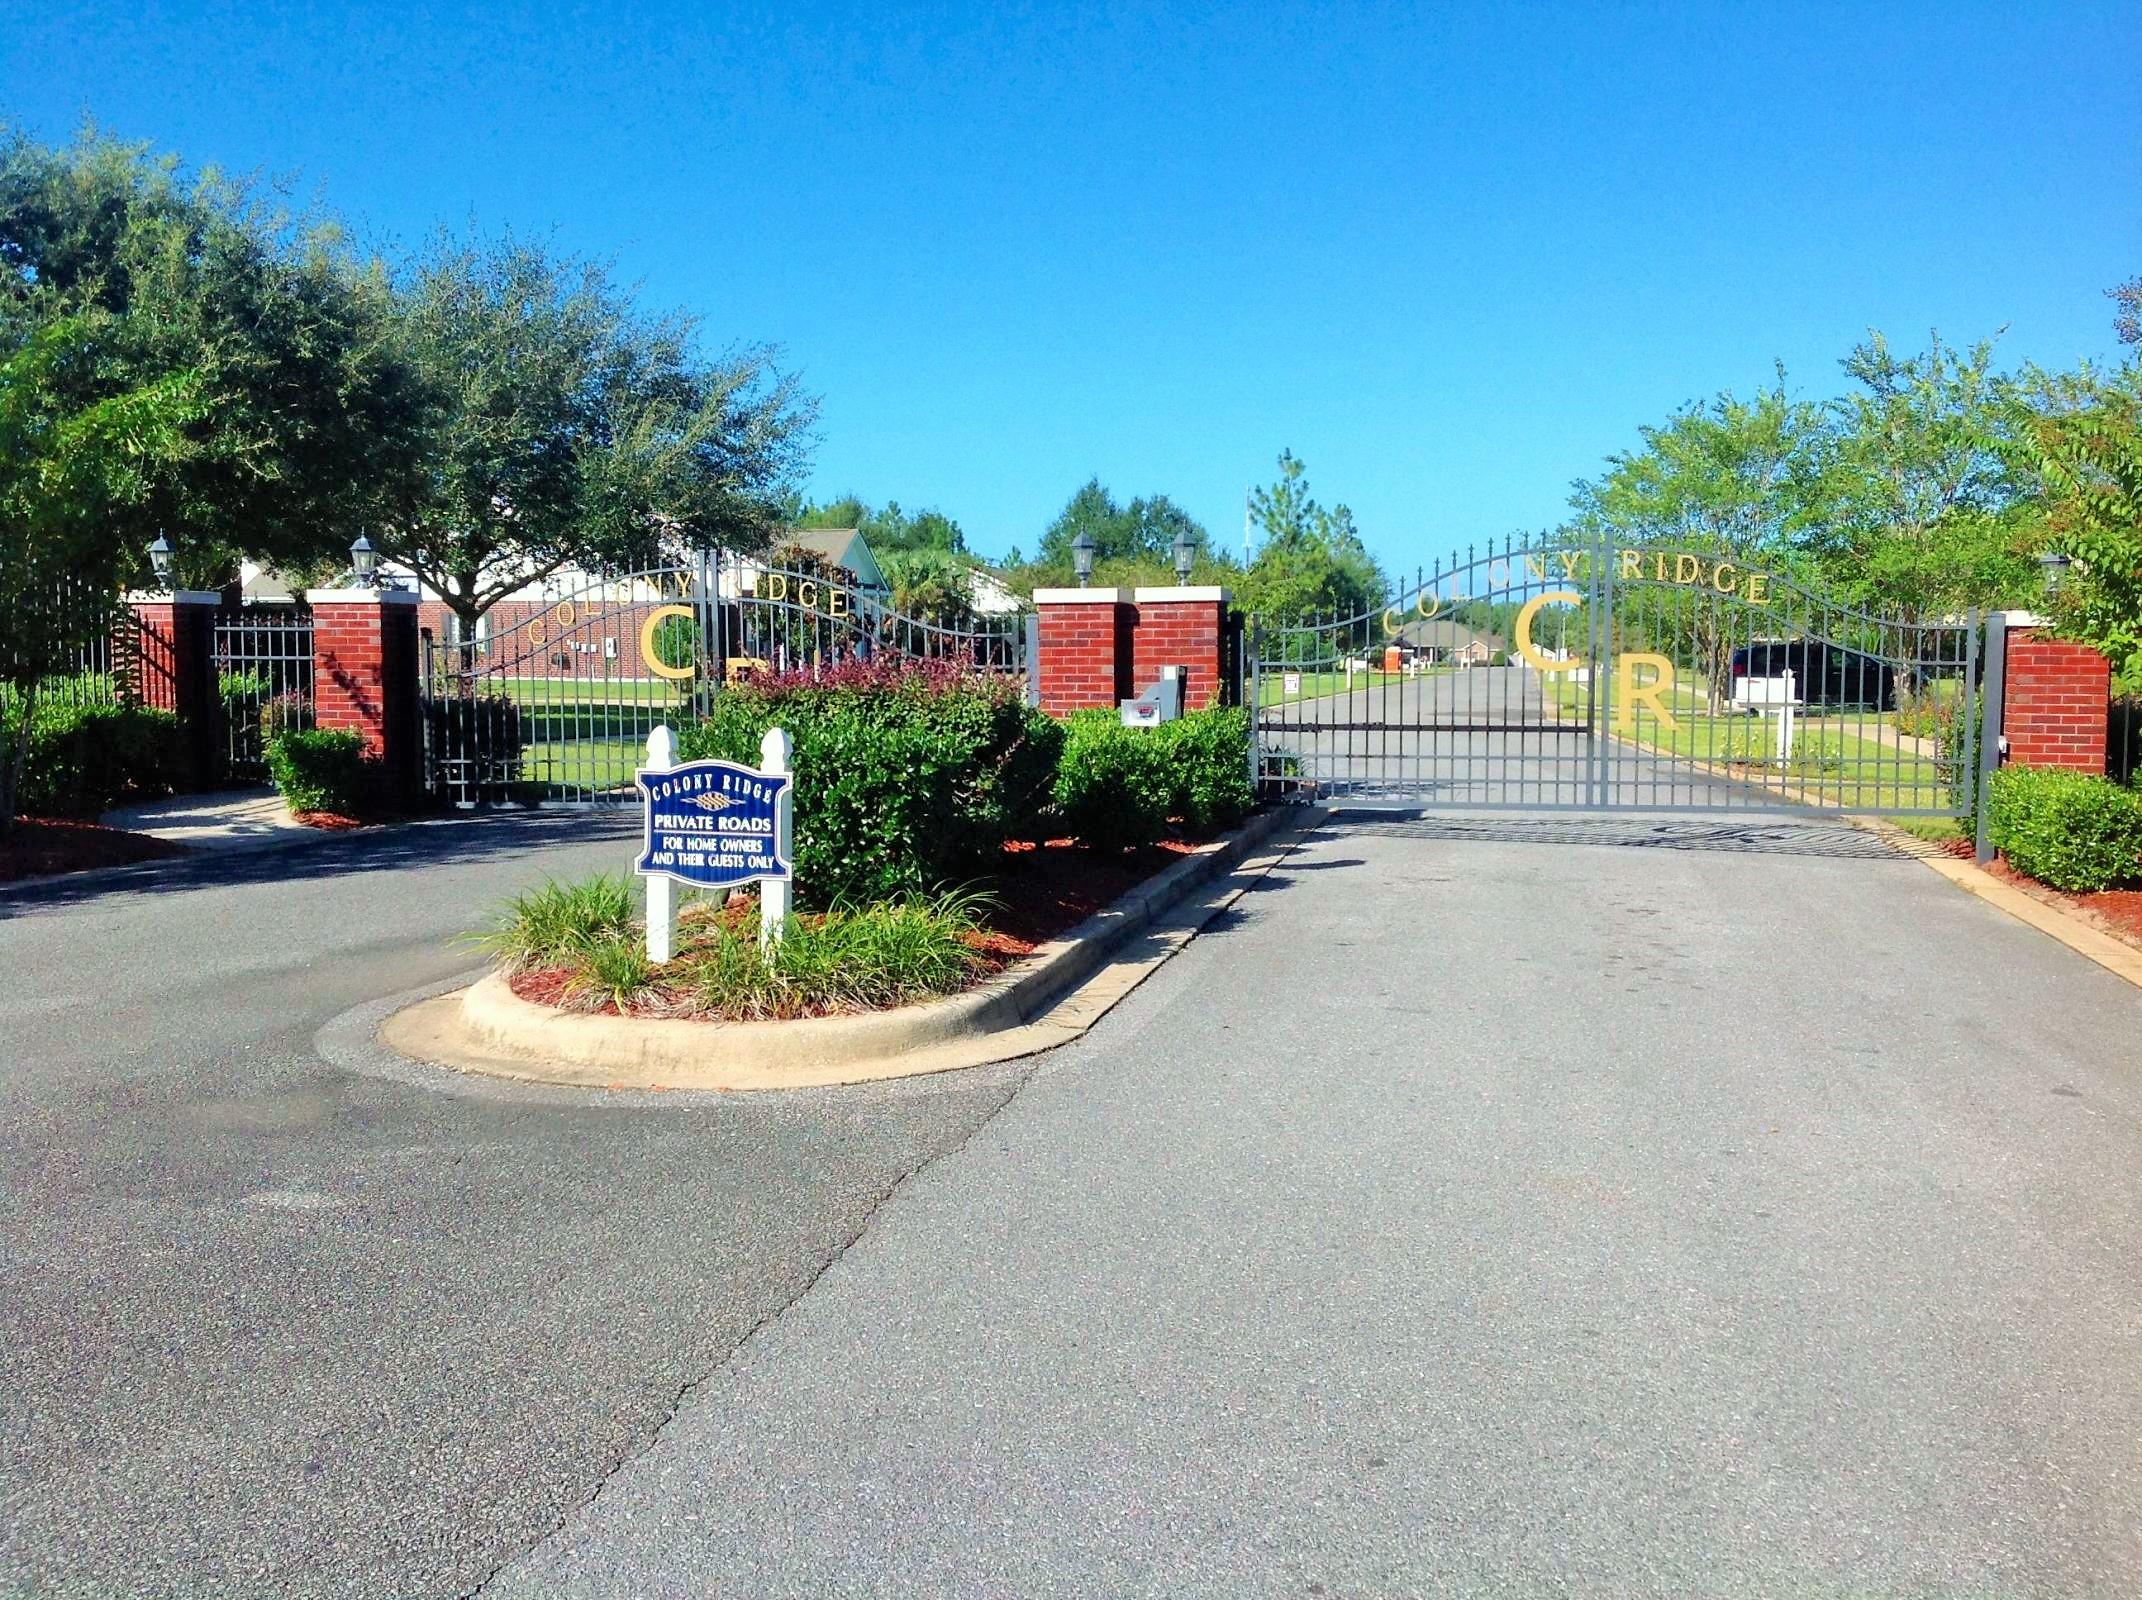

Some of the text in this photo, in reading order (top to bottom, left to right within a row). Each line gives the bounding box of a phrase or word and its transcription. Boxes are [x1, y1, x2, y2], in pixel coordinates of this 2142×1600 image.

[529, 571, 694, 645] COLONY
[1383, 550, 1771, 635] COLONY RIDGE
[641, 605, 695, 679] C
[1515, 592, 1580, 671] C
[1618, 653, 1680, 730] R
[653, 774, 772, 804] COLONY RIDGE
[655, 815, 771, 831] PRIVATE ROADS
[652, 853, 774, 868] AND THEIR GUESTS ONLY
[663, 837, 762, 852] FOR HOME OWNERS
